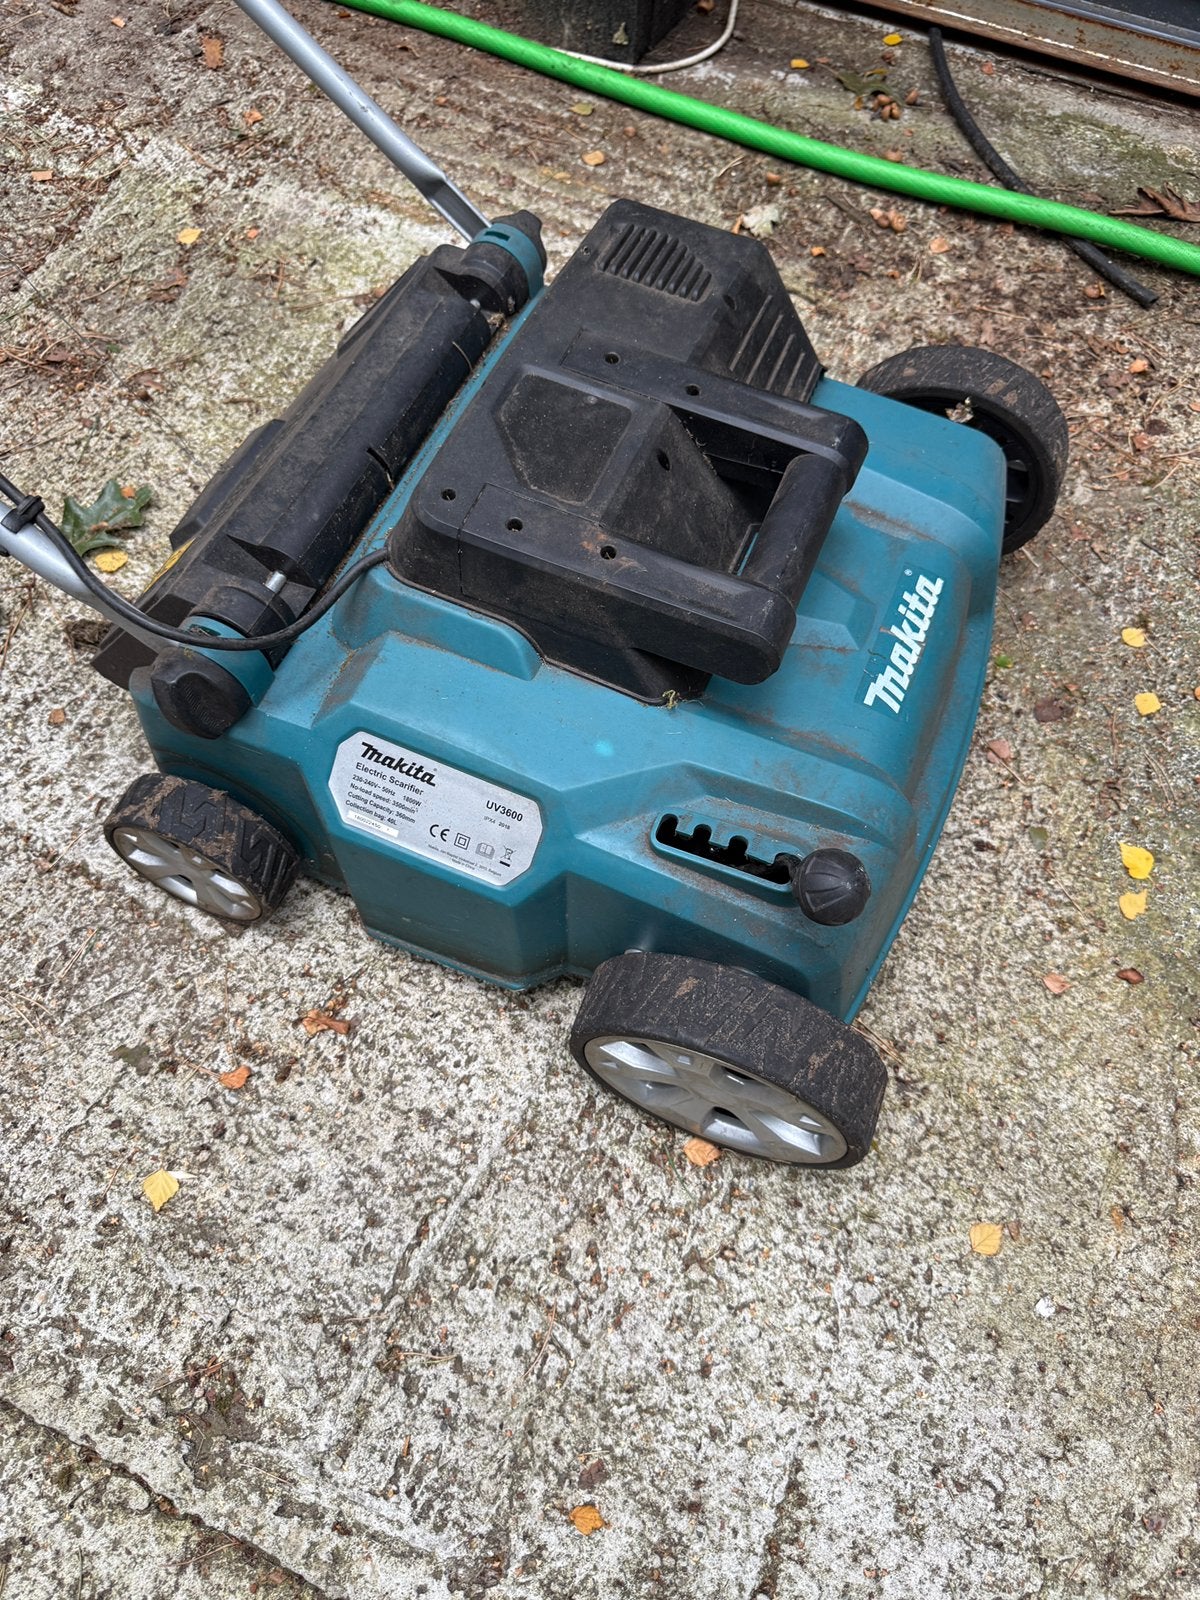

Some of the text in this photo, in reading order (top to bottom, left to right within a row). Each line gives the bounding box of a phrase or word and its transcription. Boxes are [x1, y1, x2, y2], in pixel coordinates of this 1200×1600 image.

[356, 762, 424, 796] Electric Scarifier
[345, 799, 373, 815] Collection
[347, 791, 369, 805] Cutting
[395, 810, 416, 824] 360mm
[486, 800, 523, 822] UV3600
